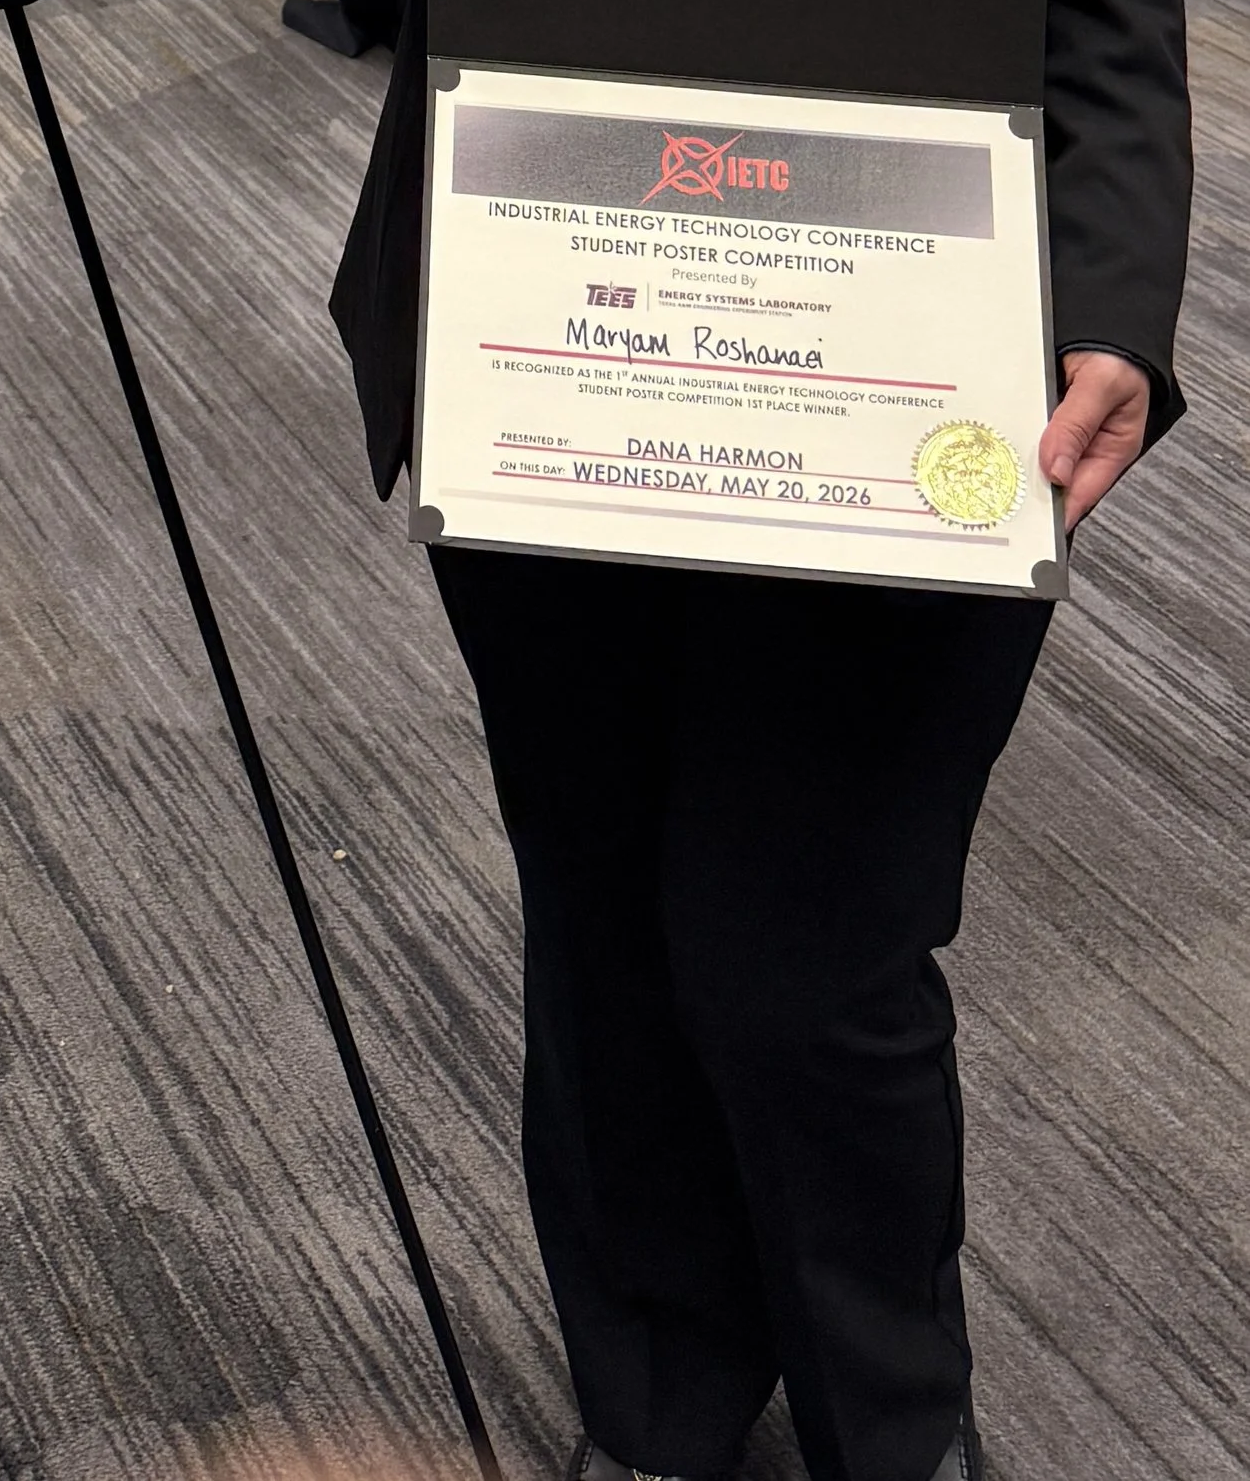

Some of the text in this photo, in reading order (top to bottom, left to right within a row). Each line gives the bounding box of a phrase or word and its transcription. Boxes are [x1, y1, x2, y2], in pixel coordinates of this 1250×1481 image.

[727, 157, 789, 191] IETC
[488, 201, 936, 254] INDUSTRIAL ENERGY TECHNOLOGY CONFERENCE
[570, 235, 854, 275] STUDENT POSTER COMPETITION
[671, 267, 758, 290] Presented By
[658, 289, 702, 302] ENERGY
[705, 293, 756, 306] SYSTEMS
[760, 299, 832, 312] LABORATORY
[567, 318, 824, 370] Maryam Roshanaei
[492, 359, 501, 370] IS
[504, 360, 575, 377] RECOGNIZED
[577, 368, 591, 379] AS
[594, 369, 612, 380] THE
[631, 373, 675, 386] ANNUAL
[678, 377, 739, 392] INDUSTRIAL
[743, 382, 785, 395] ENERGY
[788, 386, 865, 402] TECHNOLOGY
[868, 393, 944, 409] CONFERENCE
[578, 383, 851, 417] STUDENT POSTER COMPETITION 1ST PLACE WINNER.
[501, 431, 554, 446] PRESENTED
[627, 438, 803, 472] DANA HARMON
[499, 460, 517, 471] ON
[519, 462, 540, 474] THIS
[573, 462, 871, 506] WEDNESDAY, MAY 20, 2026
